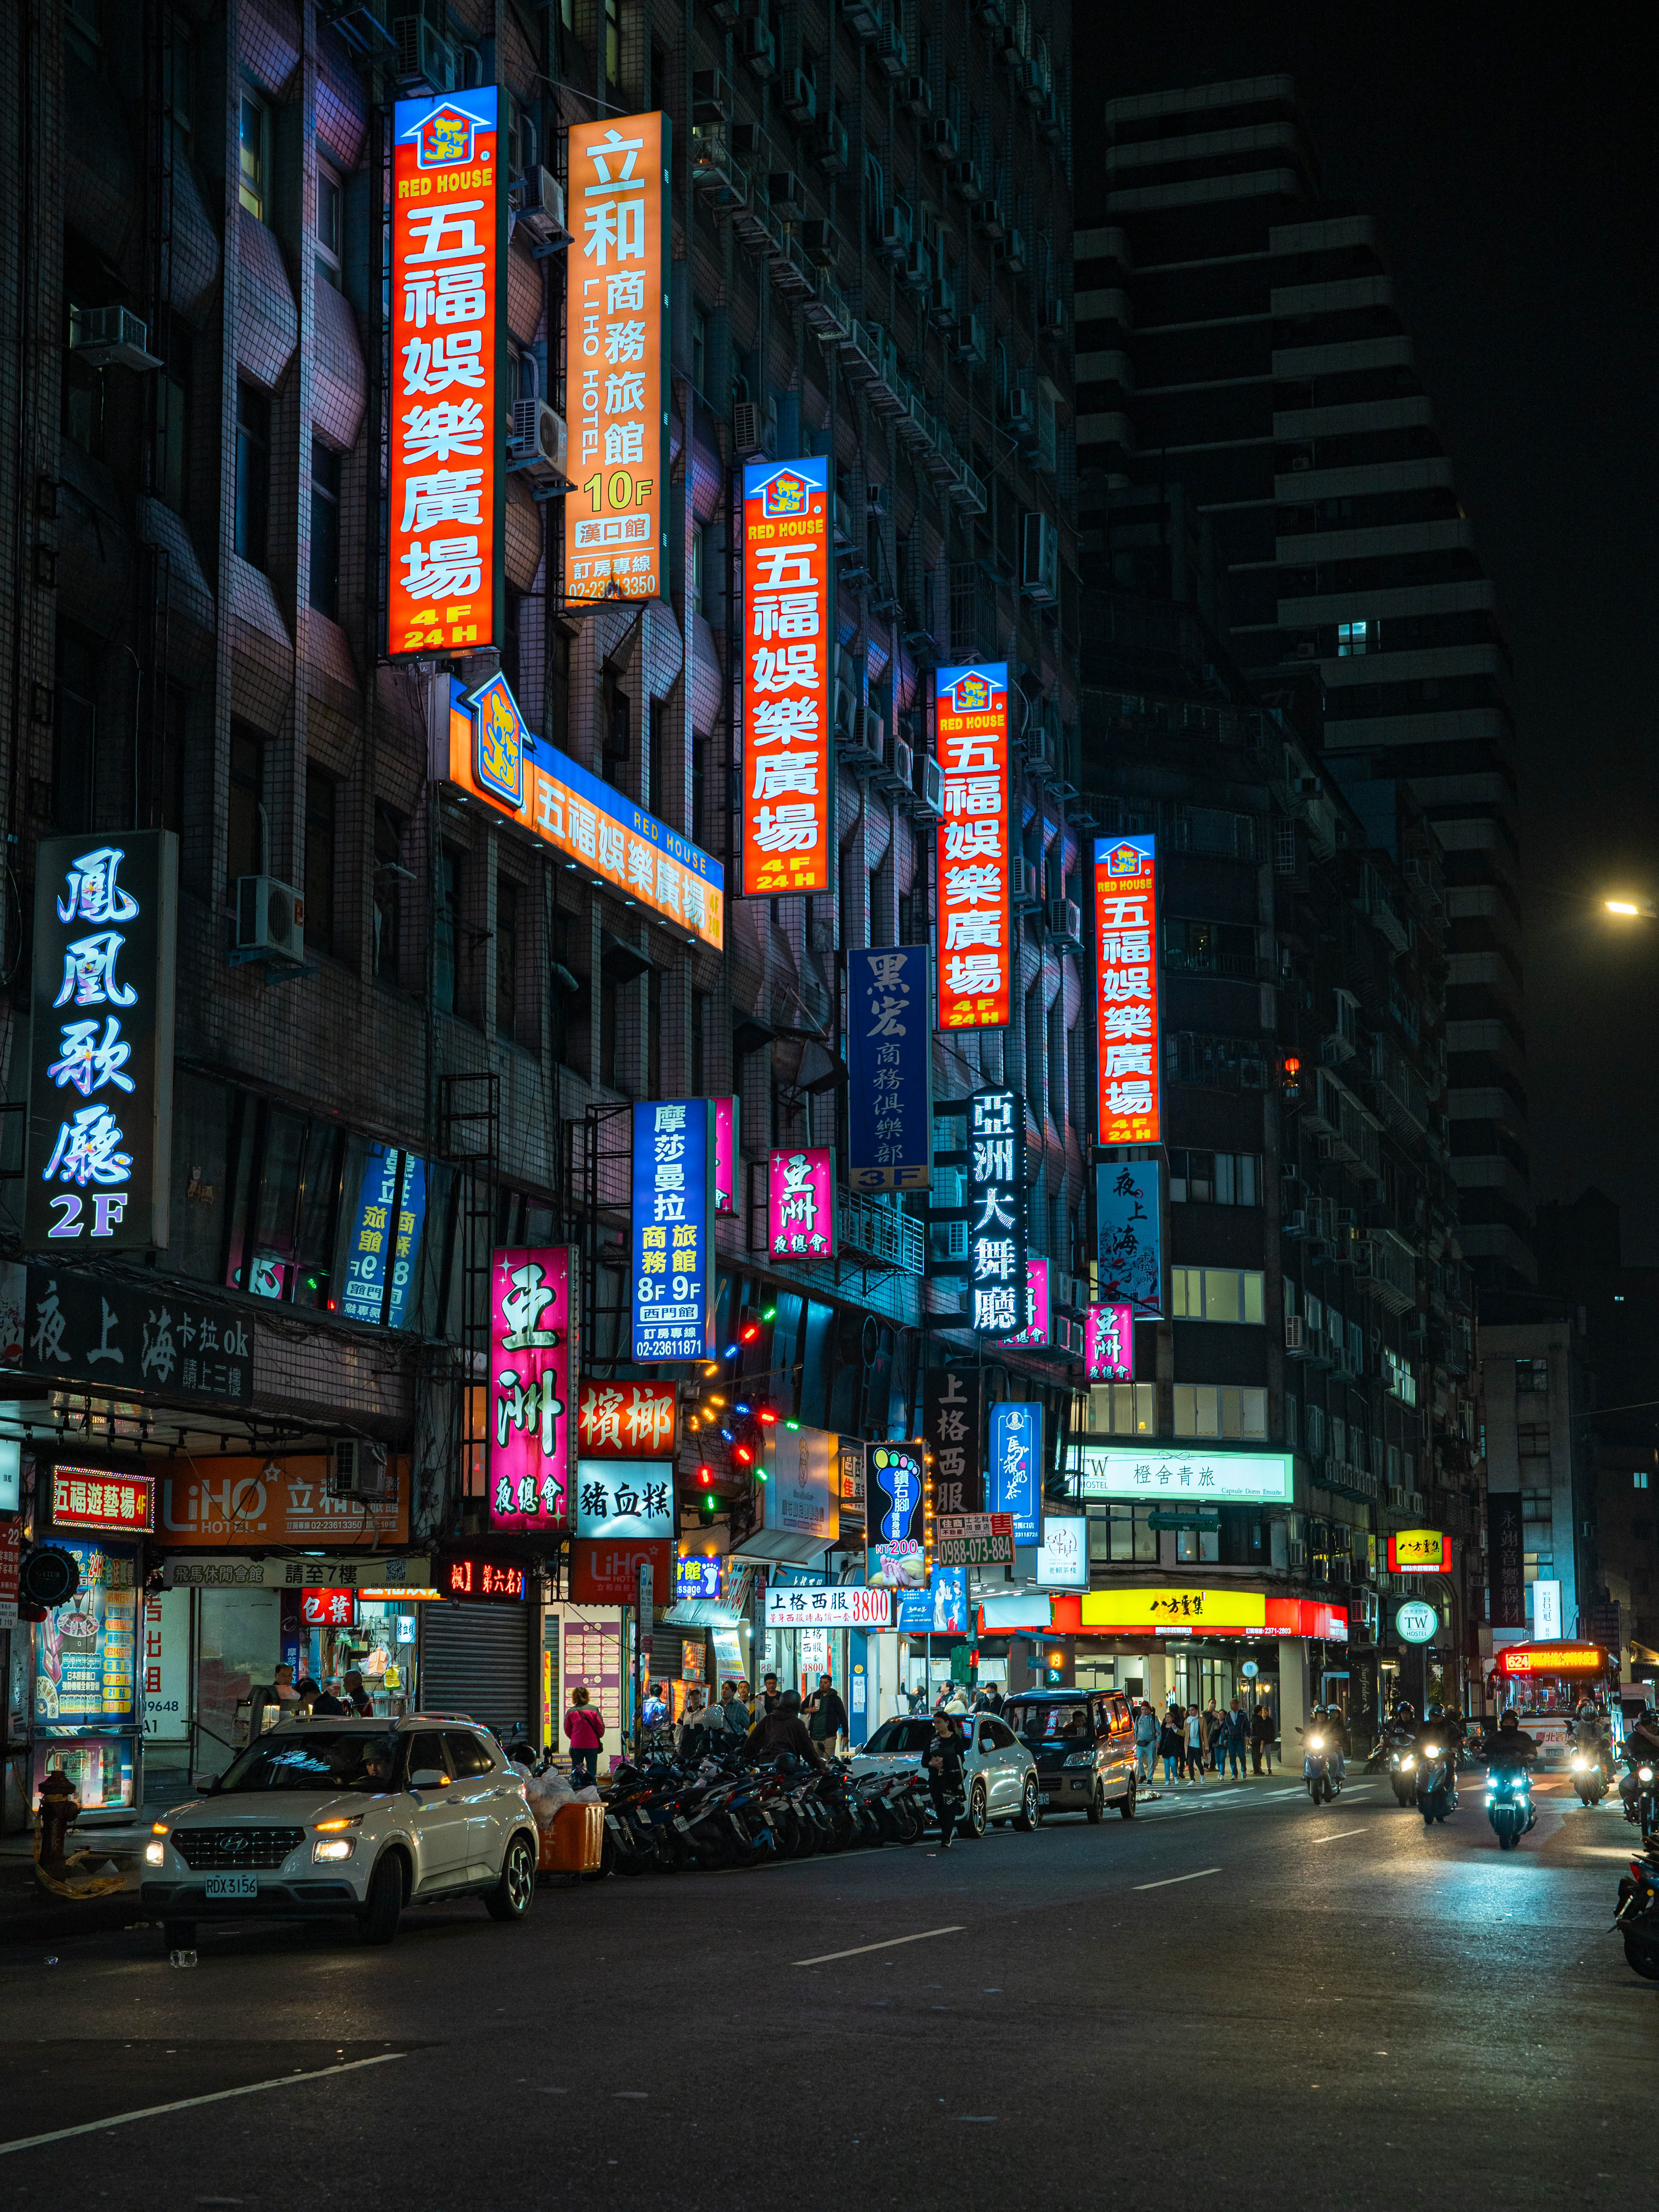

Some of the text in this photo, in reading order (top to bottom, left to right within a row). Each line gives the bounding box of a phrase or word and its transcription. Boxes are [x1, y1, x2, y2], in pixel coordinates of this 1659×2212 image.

[398, 168, 493, 198] RED HOUSE
[582, 279, 600, 465] LIHO HOTEL
[400, 200, 486, 600] 五福娛樂廣場
[584, 470, 653, 512] 10F
[580, 518, 645, 545] 漢口館
[748, 519, 823, 540] RED HOUSE
[573, 555, 651, 580] 訂房專線
[569, 575, 655, 602] 02-23613350
[752, 543, 820, 853] 五福娛樂廣場
[940, 714, 1004, 731] RED HOUSE
[537, 778, 706, 929] 五福娛樂廣場
[634, 812, 706, 875] RED HOUSE
[944, 735, 1002, 995] 五福娛樂廣場
[1098, 879, 1152, 892] RED HOUSE
[43, 846, 140, 1186] 鳳凰歌廳
[1102, 895, 1153, 1115] 五福娛樂廣場
[873, 1042, 904, 1165] 商務俱樂部
[654, 1104, 686, 1221] 摩莎曼拉
[858, 1168, 921, 1186] 3F
[48, 1192, 127, 1238] 2F
[973, 1091, 1016, 1330] 亞洲大舞廳
[1113, 1167, 1148, 1256] 夜上海
[774, 1233, 827, 1254] 夜總會
[638, 1275, 701, 1302] 8F 9F
[644, 1306, 694, 1319] 西門館
[30, 1280, 176, 1383] 夜上海
[644, 1327, 696, 1339] 訂房專線
[637, 1339, 701, 1357] 02-23611871
[1089, 1365, 1129, 1380] 夜總會
[579, 1387, 673, 1450] 檳榔
[936, 1374, 969, 1513] 上格西服
[1133, 1463, 1216, 1487] 橙舍青旅
[56, 1479, 135, 1519] 五福遊藝場
[495, 1474, 564, 1516] 夜總會
[579, 1481, 671, 1519] 豬血糕
[1222, 1487, 1243, 1495] Capsule
[136, 1495, 146, 1515] 4F
[201, 1520, 254, 1534] HOTEL
[311, 1520, 362, 1530] 02-23613350
[942, 1519, 963, 1528] 住商
[990, 1514, 1011, 1536] 售
[941, 1536, 1011, 1564] 0988-073-884
[1399, 1539, 1440, 1553] 八方雲集
[88, 1555, 104, 1577] 24H
[174, 1565, 264, 1584] 飛馬休閒會館
[285, 1564, 357, 1584] 請至7樓
[303, 1595, 350, 1624] 包葉
[770, 1592, 849, 1610] 上格西服
[853, 1591, 888, 1621] 3800
[1150, 1595, 1203, 1616] 八方雲集
[1543, 1597, 1551, 1621] 君冠
[1405, 1615, 1427, 1628] TW
[803, 1643, 823, 1653] 西服
[1052, 1654, 1060, 1666] 19
[803, 1663, 823, 1672] 3800
[1508, 1656, 1529, 1667] 624
